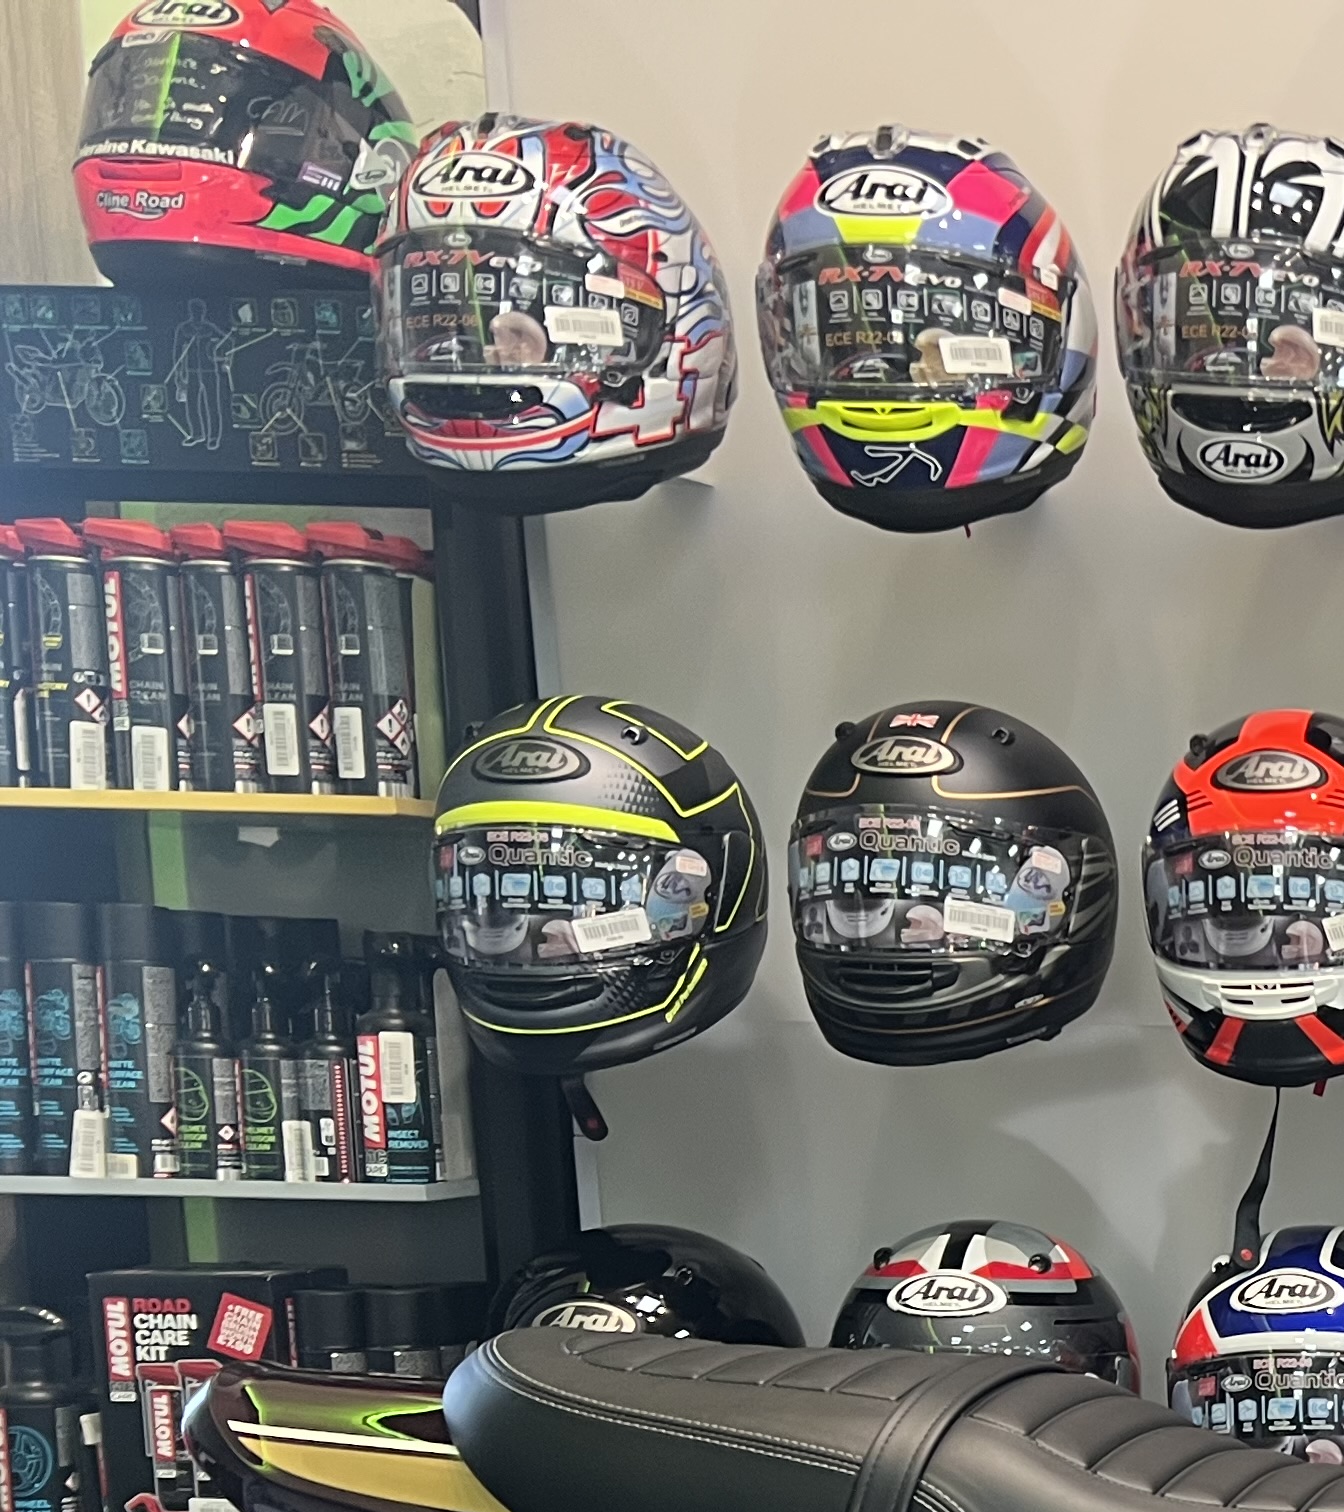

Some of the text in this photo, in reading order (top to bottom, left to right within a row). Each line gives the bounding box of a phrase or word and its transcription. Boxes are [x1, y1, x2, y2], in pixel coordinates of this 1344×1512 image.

[129, 140, 233, 166] Kawasaki
[432, 156, 518, 184] Arai
[97, 190, 184, 209] Cline Road
[830, 174, 930, 202] Arai
[1207, 444, 1271, 469] Arai
[498, 745, 564, 769] Arai
[870, 739, 939, 765] Arai
[1238, 753, 1304, 778] Arai
[860, 831, 960, 855] Quantic
[489, 846, 593, 867] Quantic
[1232, 847, 1334, 869] Quantic
[358, 1041, 381, 1143] MOTUL
[388, 1140, 429, 1149] REMOVER
[915, 1276, 988, 1303] Arai
[1256, 1278, 1321, 1299] Arai
[133, 1298, 191, 1313] ROAD
[133, 1314, 198, 1330] CHAIN
[552, 1306, 622, 1332] Arai
[106, 1301, 131, 1377] MOTUL
[135, 1330, 189, 1346] CARE
[136, 1346, 169, 1361] KIT
[1223, 1376, 1250, 1388] Arai
[153, 1395, 173, 1457] MOTUL
